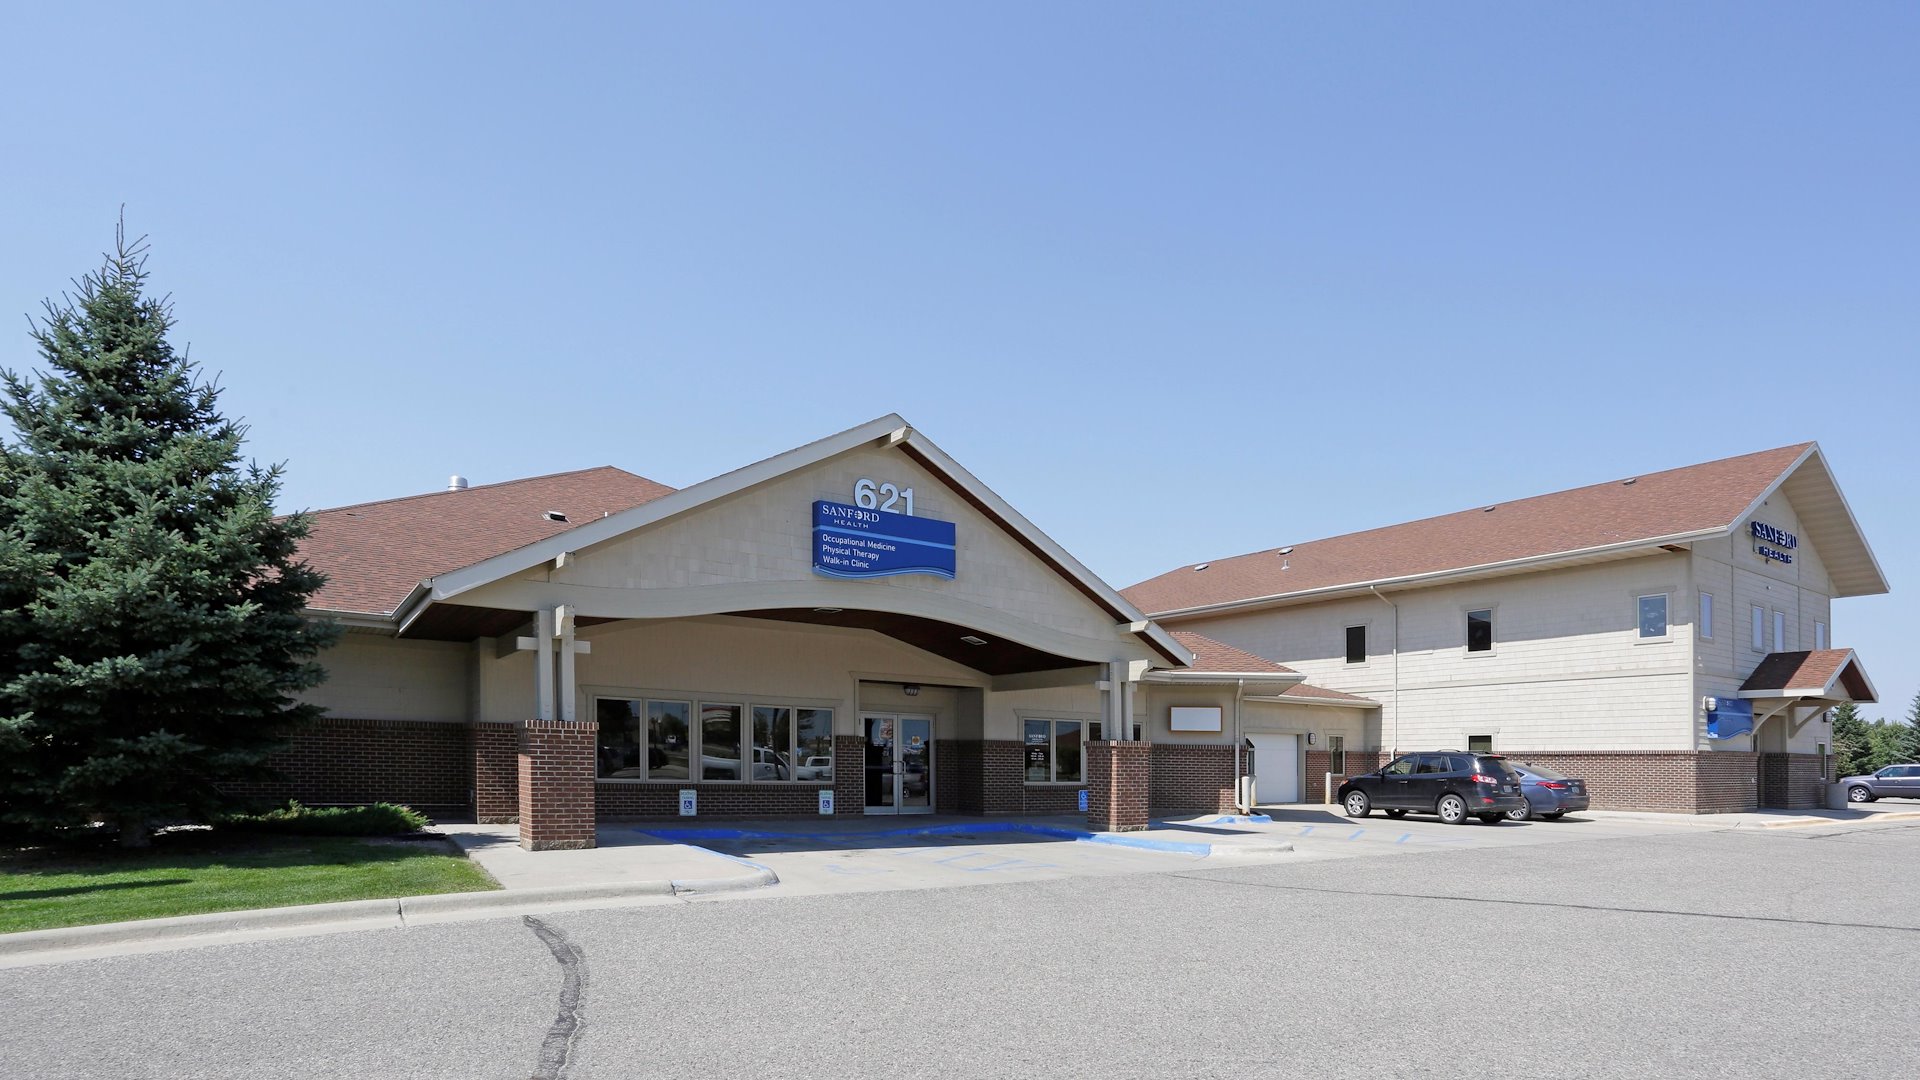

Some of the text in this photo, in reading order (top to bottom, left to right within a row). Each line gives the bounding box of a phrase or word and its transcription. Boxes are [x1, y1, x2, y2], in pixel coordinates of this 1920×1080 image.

[854, 478, 914, 517] 621
[822, 504, 880, 523] SANFORD
[833, 519, 869, 529] HEALTH
[822, 533, 896, 552] Occupational Medicine
[1754, 520, 1798, 549] SANFORD
[822, 544, 880, 561] Physical Therapy
[1762, 546, 1793, 564] HEALTH
[822, 555, 870, 569] Walk-in Clinic
